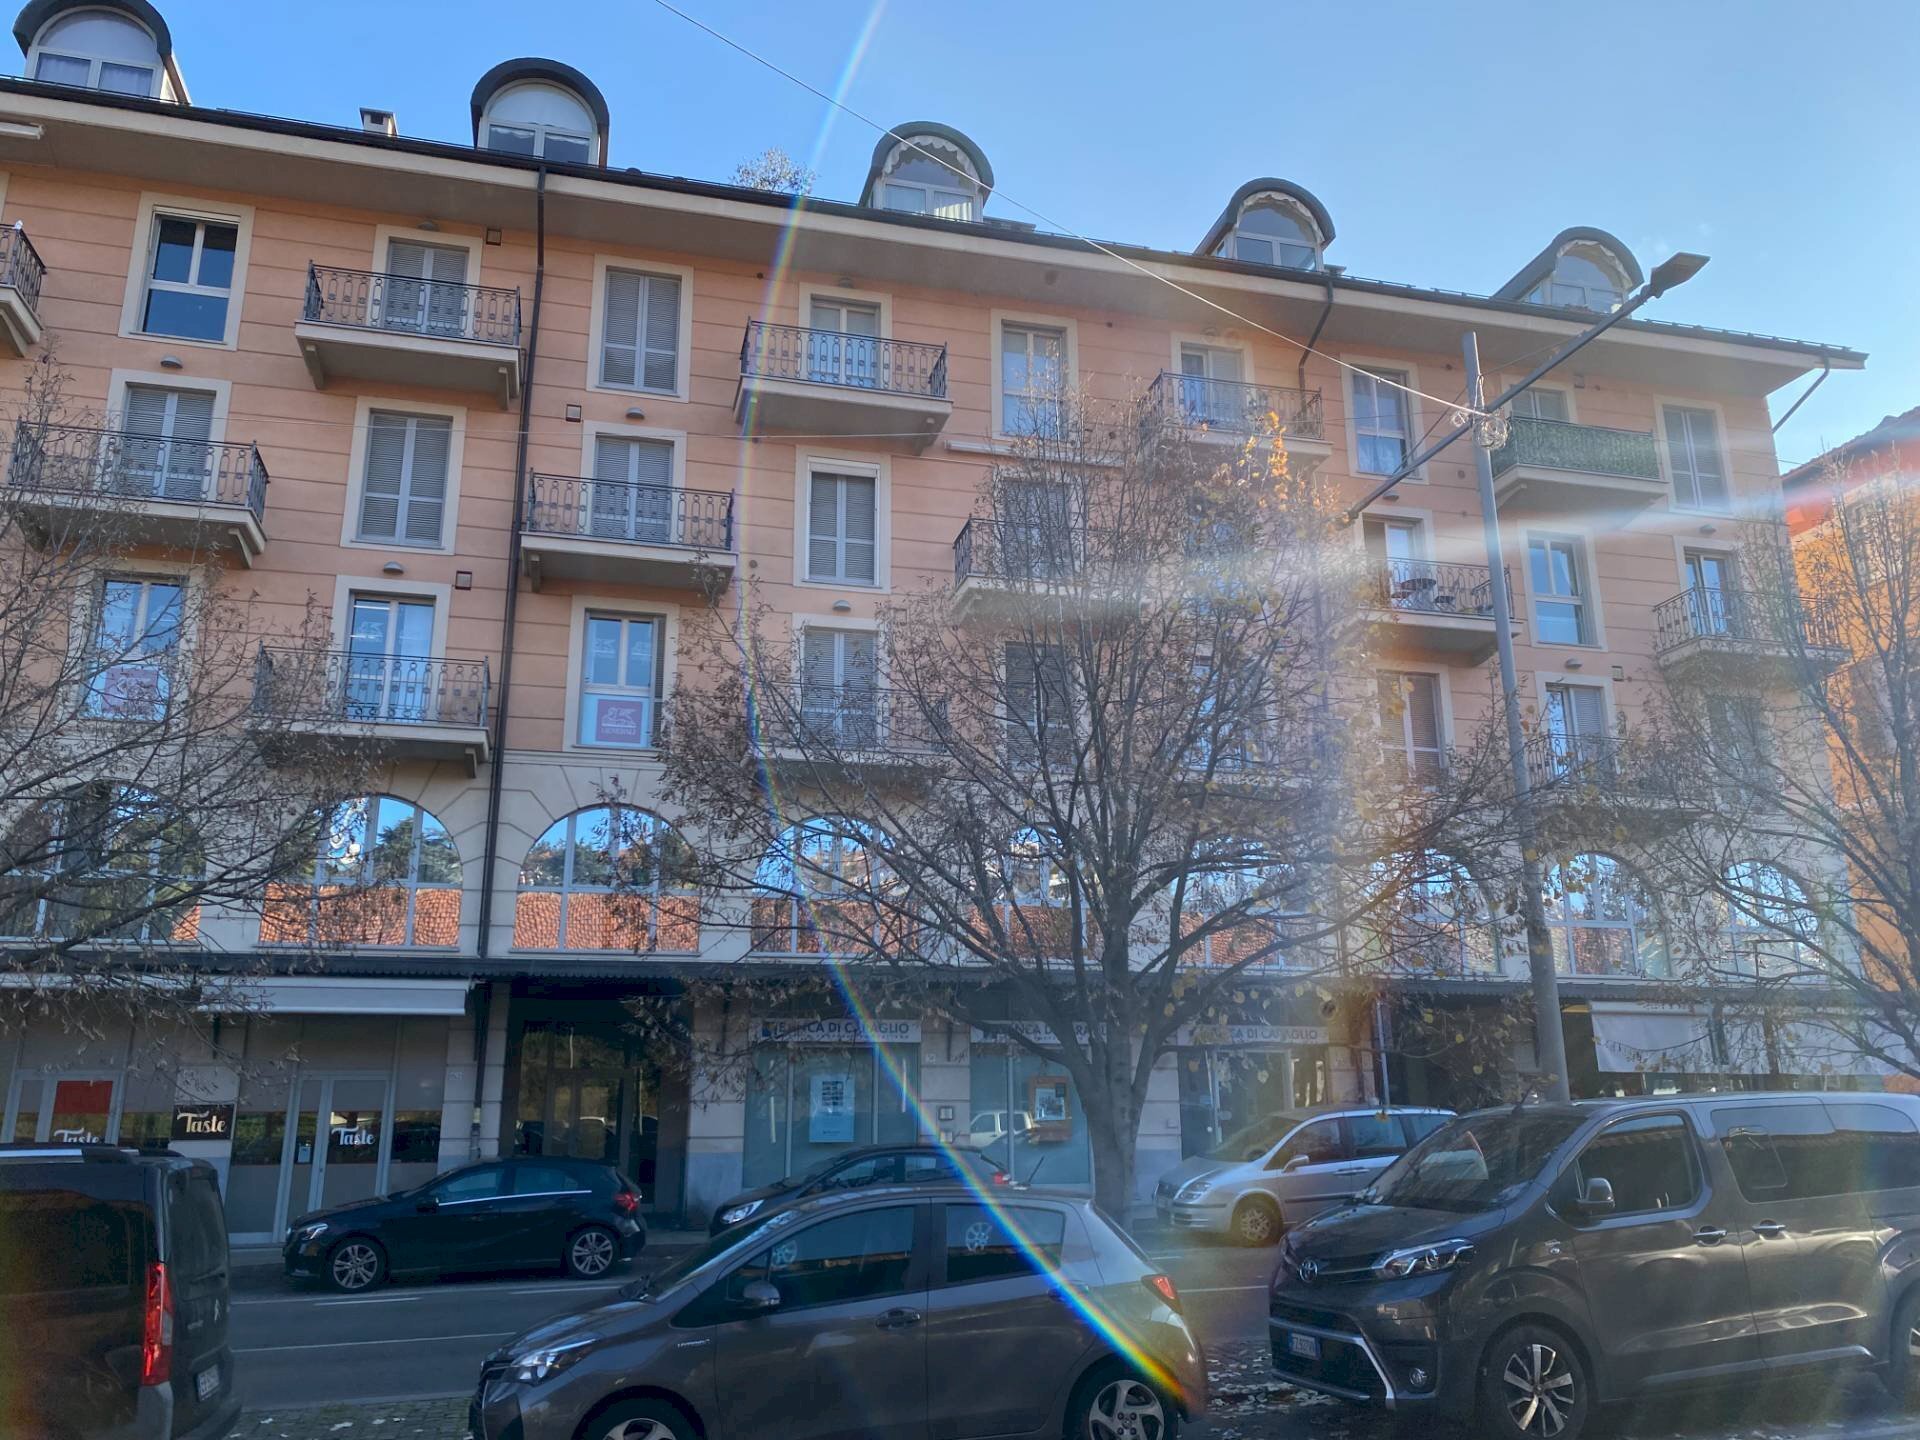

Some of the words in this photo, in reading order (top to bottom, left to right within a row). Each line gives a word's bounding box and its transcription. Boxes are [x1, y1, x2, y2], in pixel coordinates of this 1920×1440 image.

[829, 1022, 841, 1033] DI
[176, 1110, 226, 1133] Taste
[331, 1125, 375, 1146] Taste
